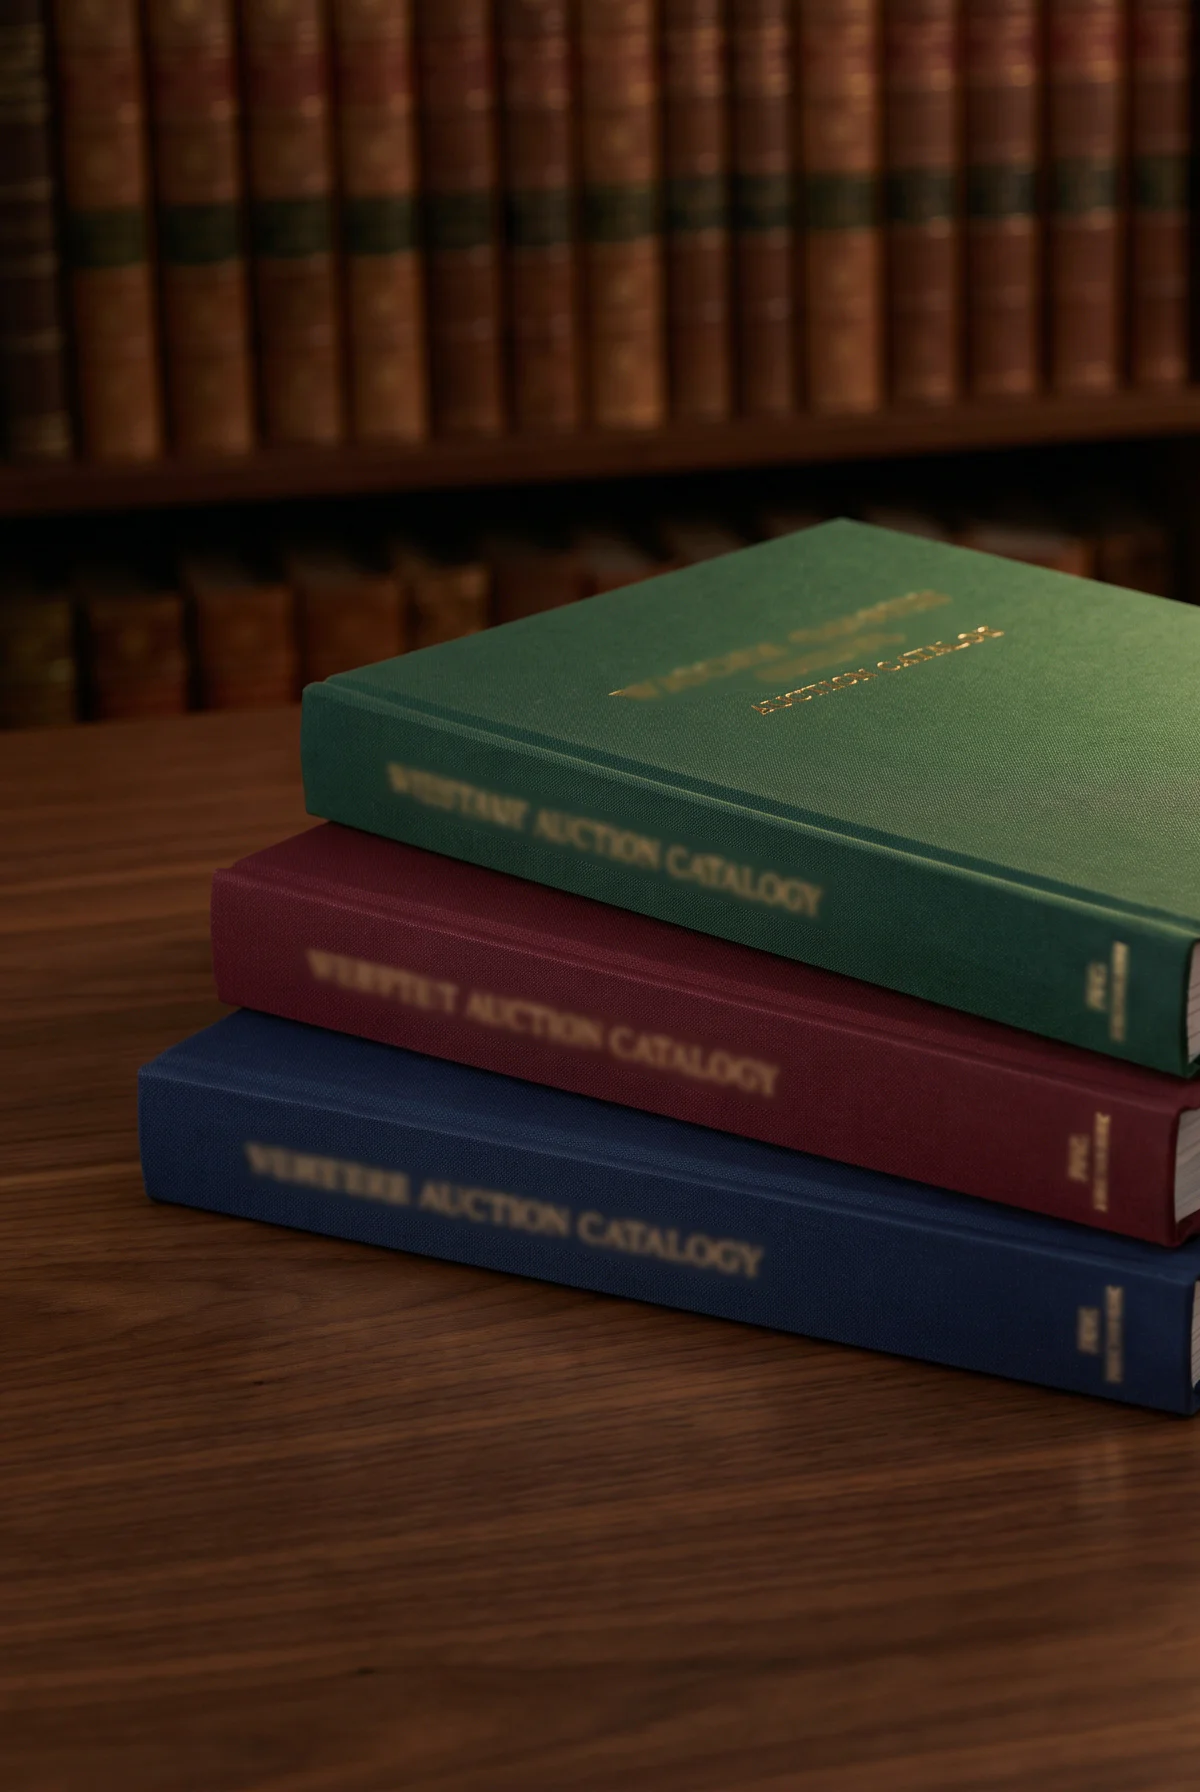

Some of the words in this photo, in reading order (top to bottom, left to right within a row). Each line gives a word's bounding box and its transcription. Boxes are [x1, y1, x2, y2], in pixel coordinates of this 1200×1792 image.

[534, 808, 660, 869] AUCTION
[465, 993, 605, 1049] AUCTION
[419, 1181, 570, 1236] AUCTION
